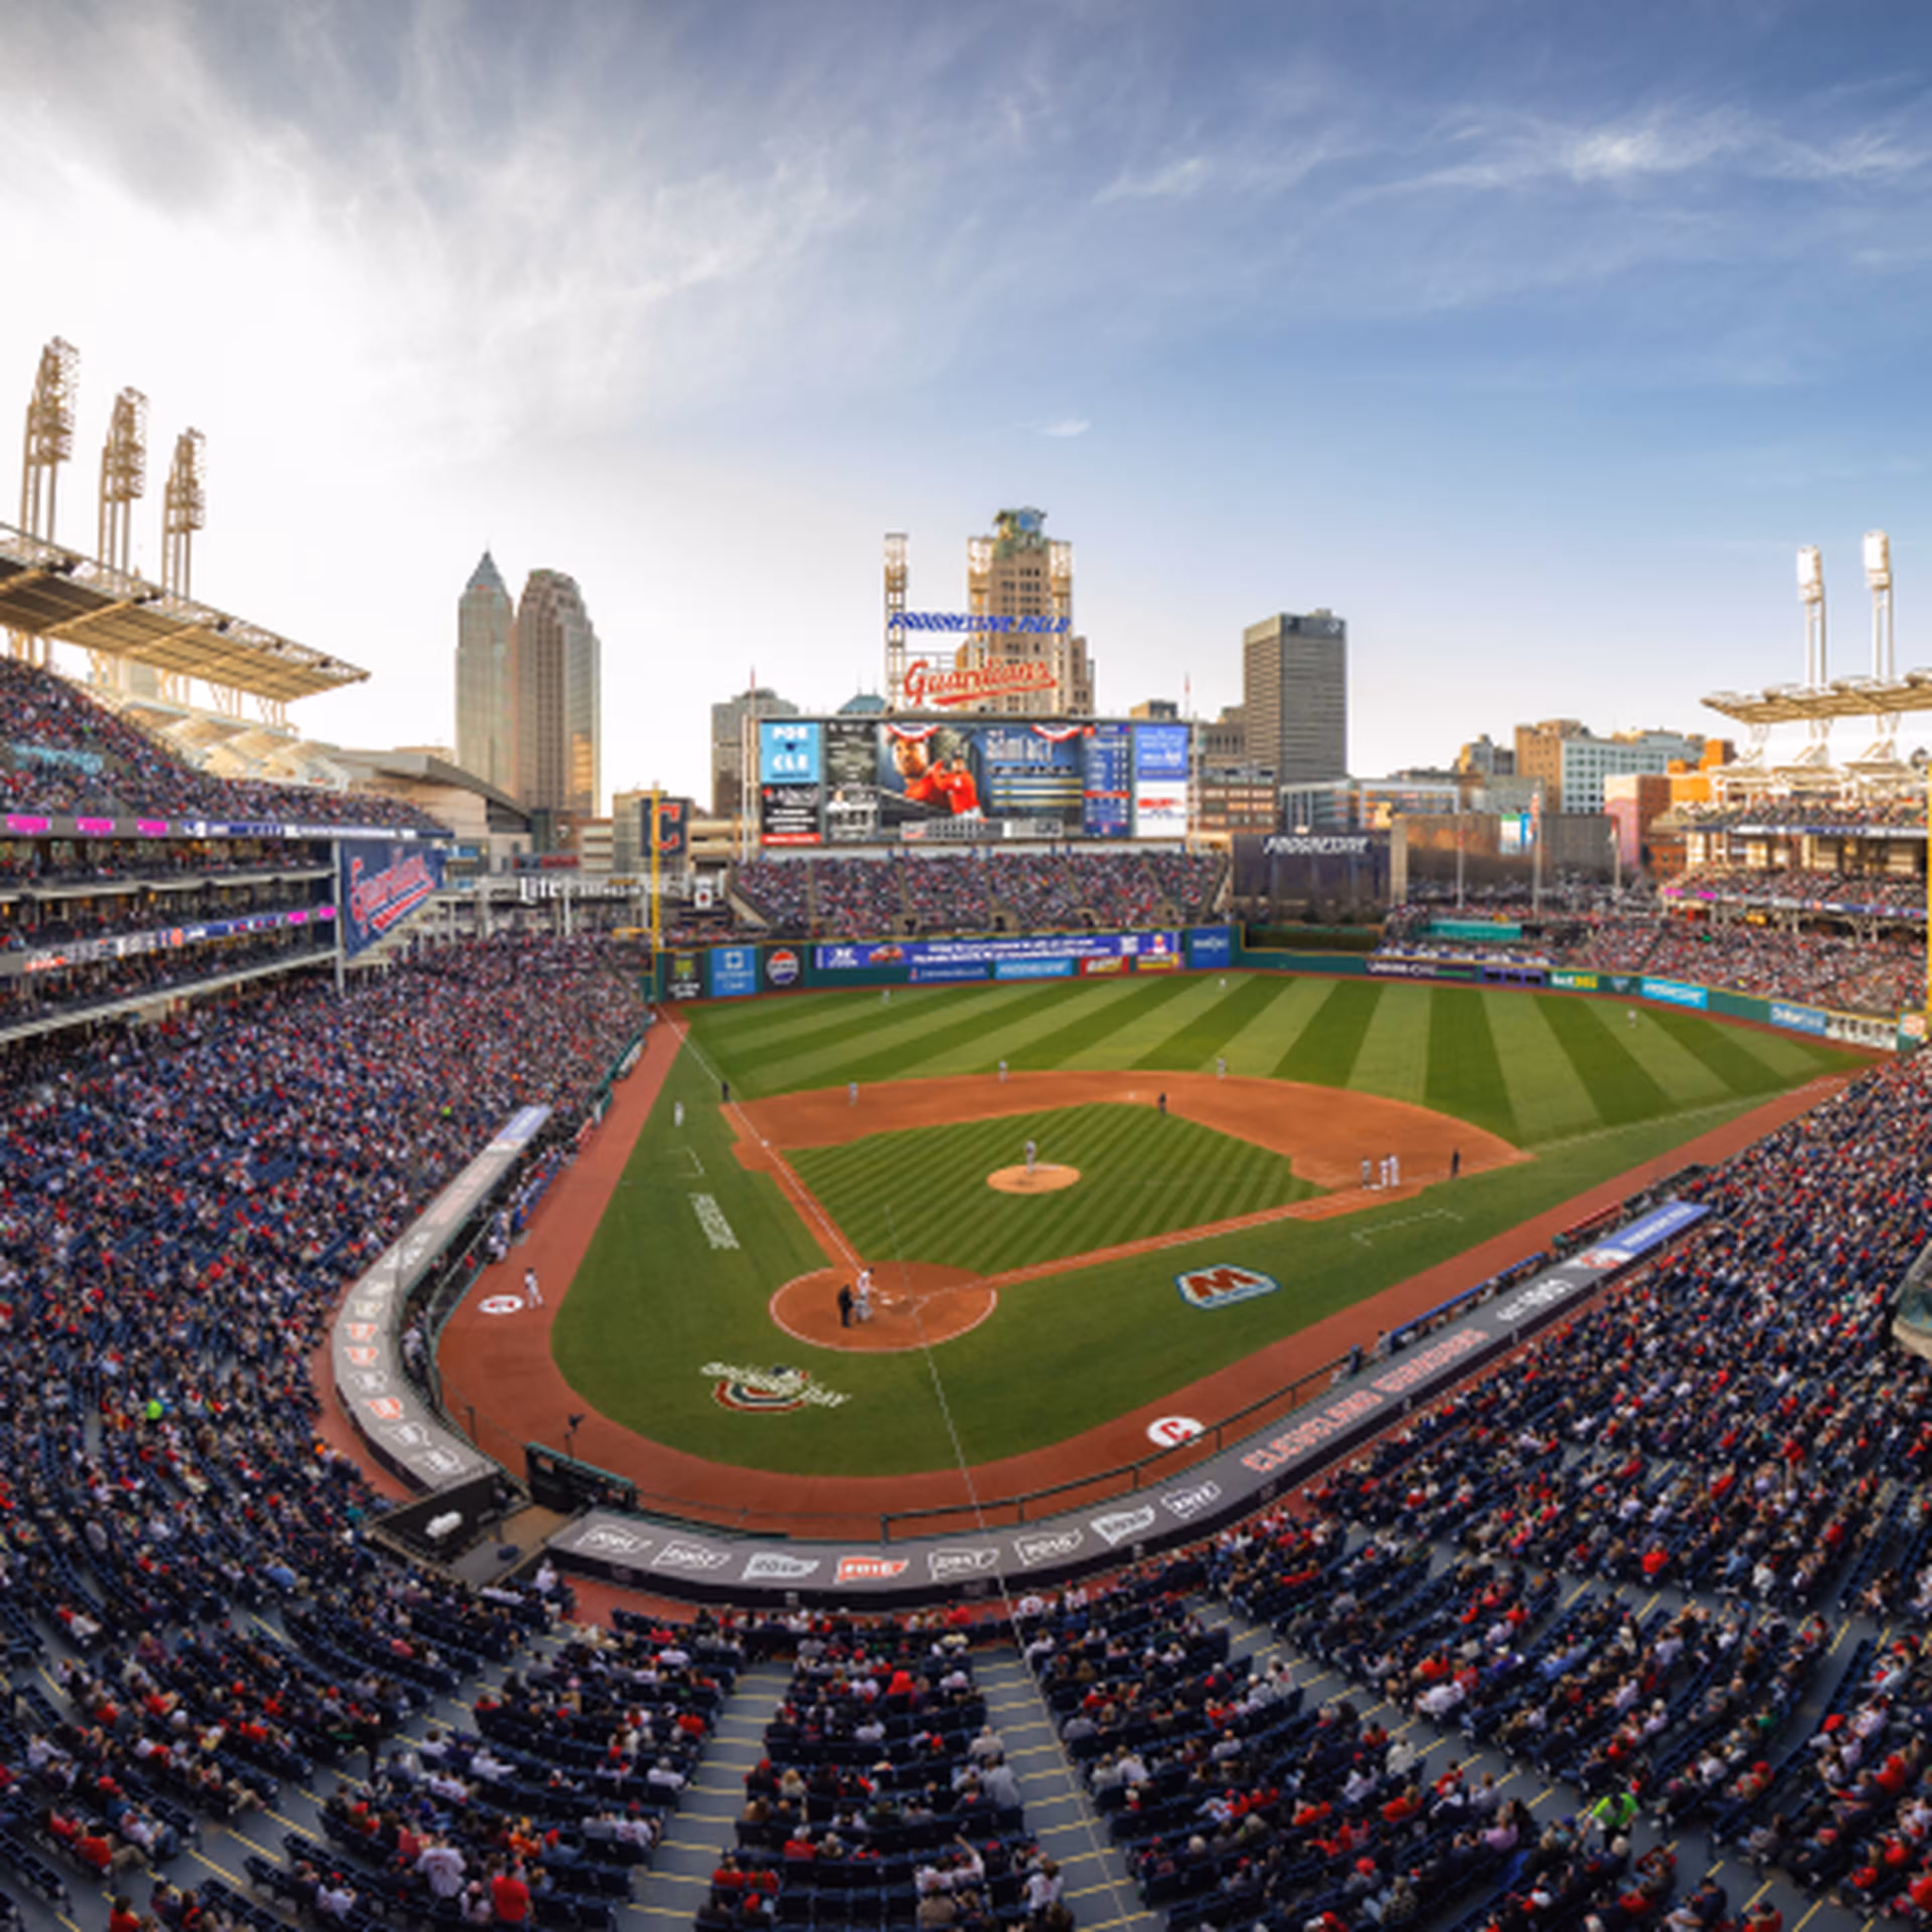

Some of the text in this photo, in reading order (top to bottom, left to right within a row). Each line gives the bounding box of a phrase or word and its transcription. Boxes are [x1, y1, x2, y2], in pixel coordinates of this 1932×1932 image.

[906, 658, 1057, 707] Guardians
[1264, 833, 1369, 854] PROGRESSIVE
[1240, 1389, 1385, 1473] CLEVELAND
